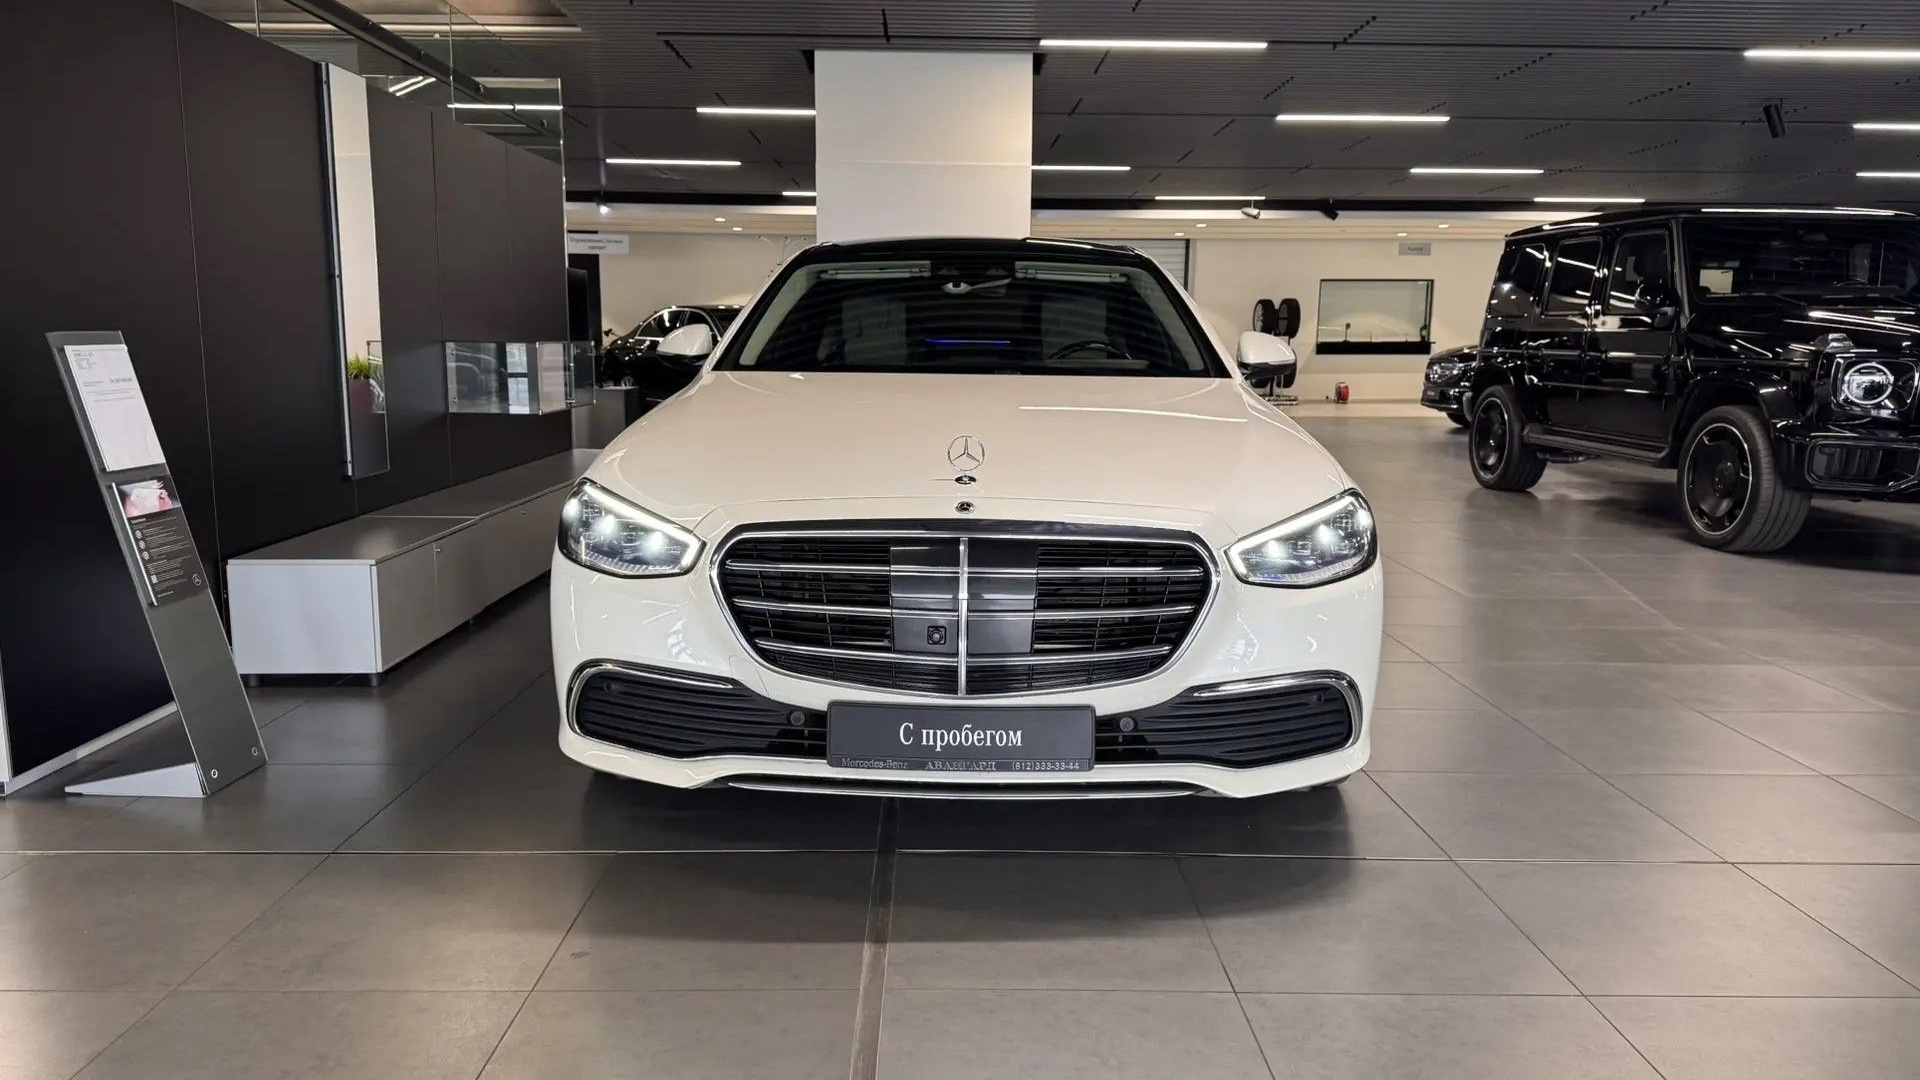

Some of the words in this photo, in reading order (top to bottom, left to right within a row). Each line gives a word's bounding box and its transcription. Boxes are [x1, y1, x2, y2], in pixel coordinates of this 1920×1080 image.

[899, 722, 914, 745] С
[920, 724, 1023, 752] пробегом
[840, 758, 909, 770] Mercedes-Benz
[924, 761, 996, 772] АВАНГАРД
